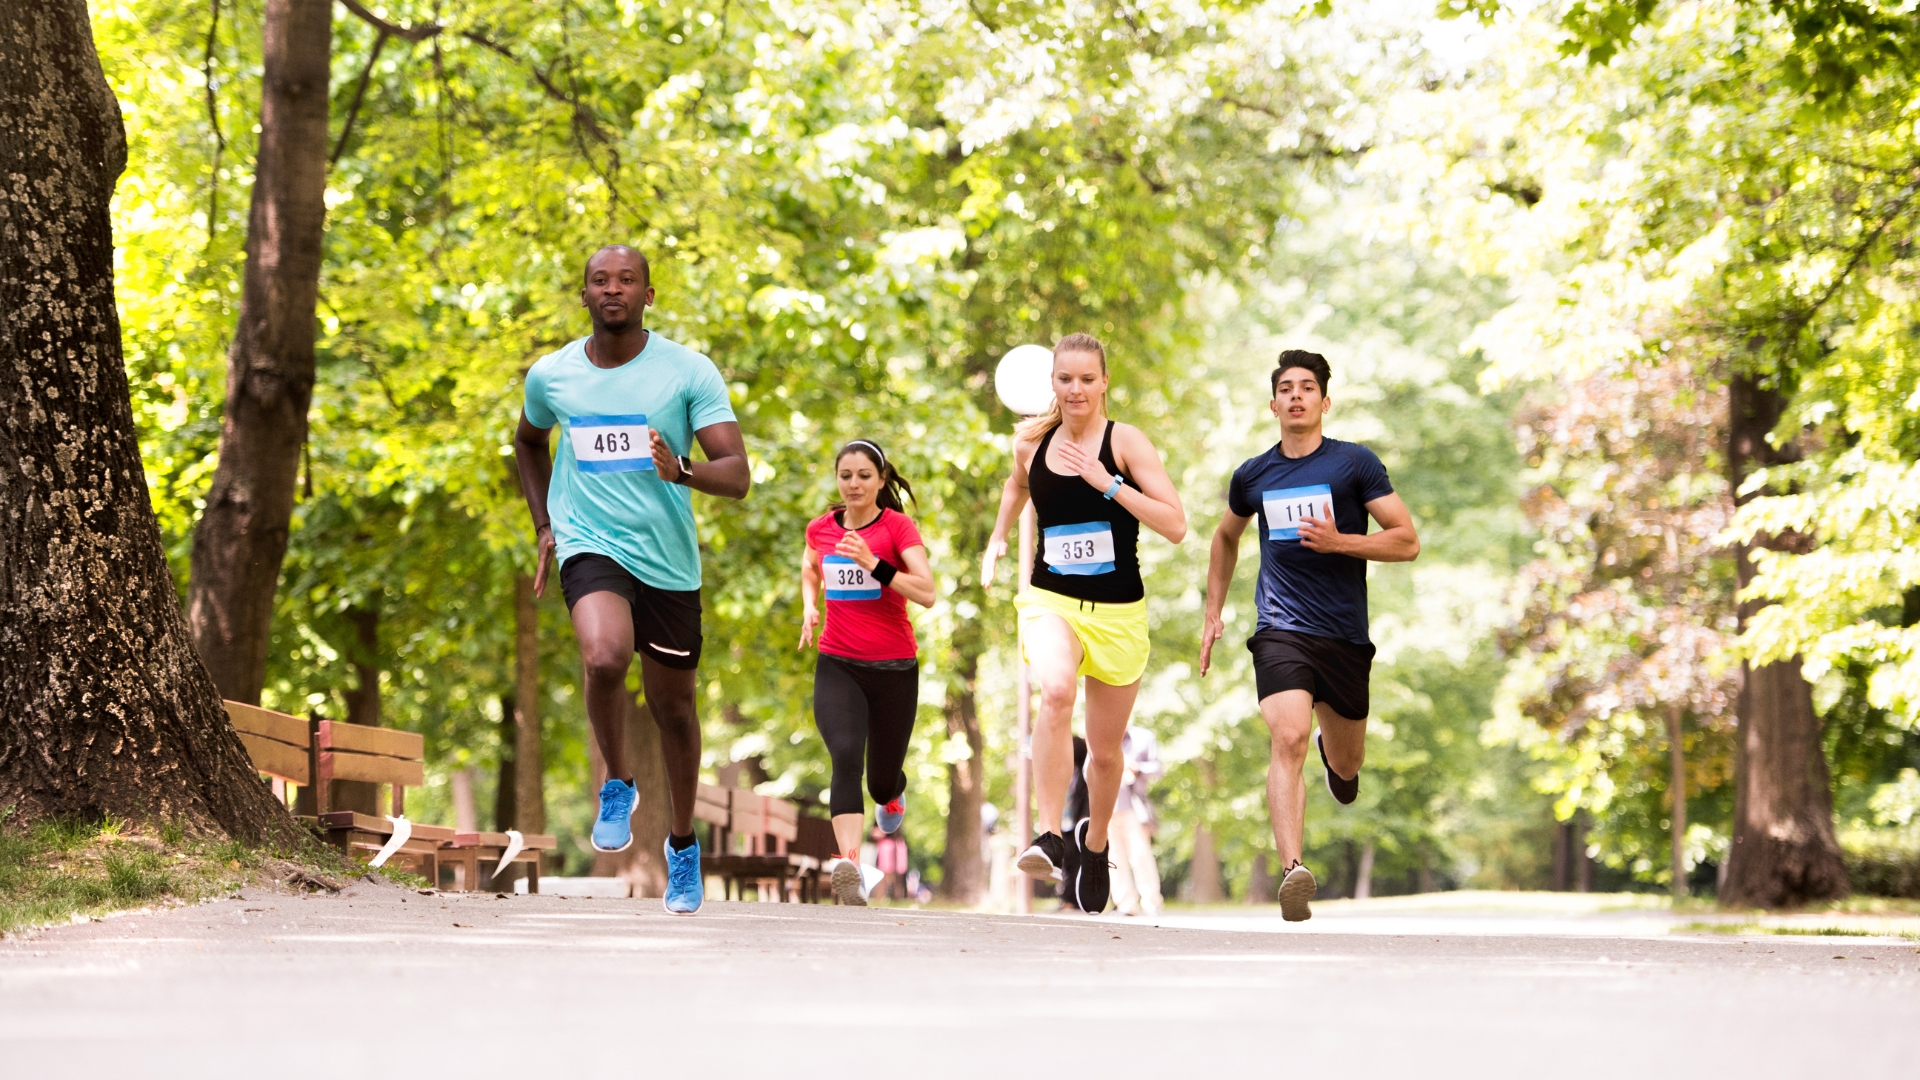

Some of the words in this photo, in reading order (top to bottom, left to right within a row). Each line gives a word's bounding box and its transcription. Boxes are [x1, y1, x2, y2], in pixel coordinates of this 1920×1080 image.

[594, 432, 631, 454] 463
[1286, 502, 1314, 522] 111
[1062, 539, 1095, 560] 353
[838, 569, 864, 585] 328
